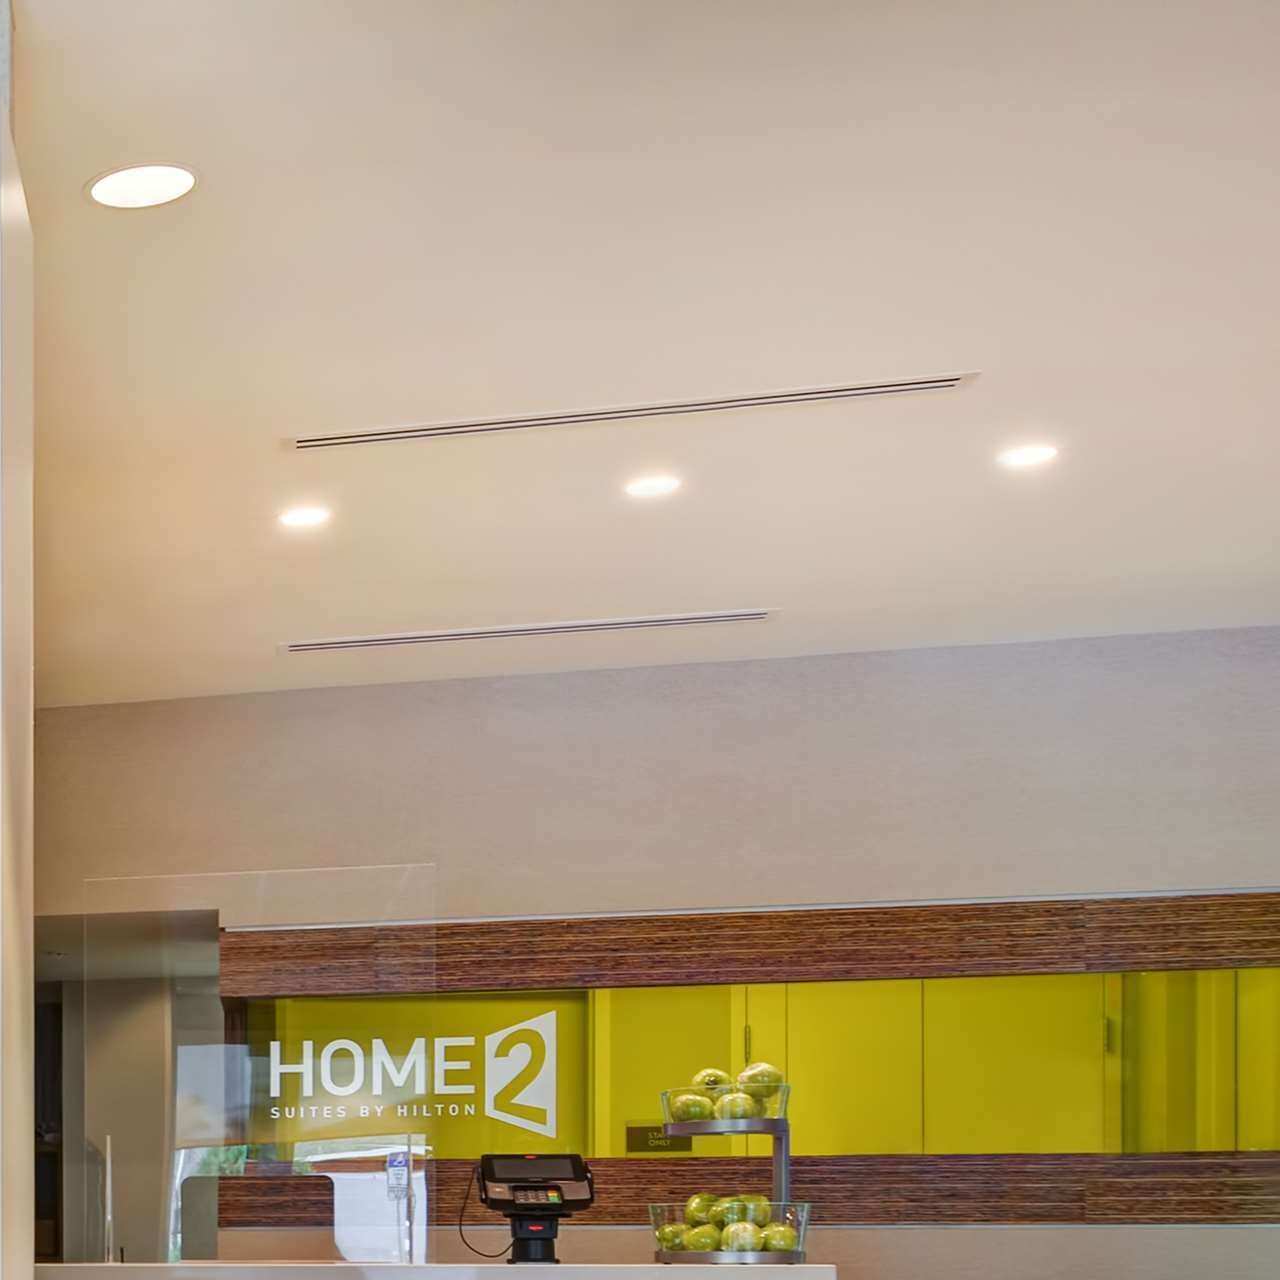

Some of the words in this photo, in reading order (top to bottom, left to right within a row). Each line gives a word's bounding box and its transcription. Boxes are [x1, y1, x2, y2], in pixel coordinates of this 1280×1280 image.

[269, 1036, 476, 1098] HOME
[270, 1105, 347, 1119] SUITES
[359, 1104, 383, 1118] BY
[396, 1103, 476, 1117] HILTON
